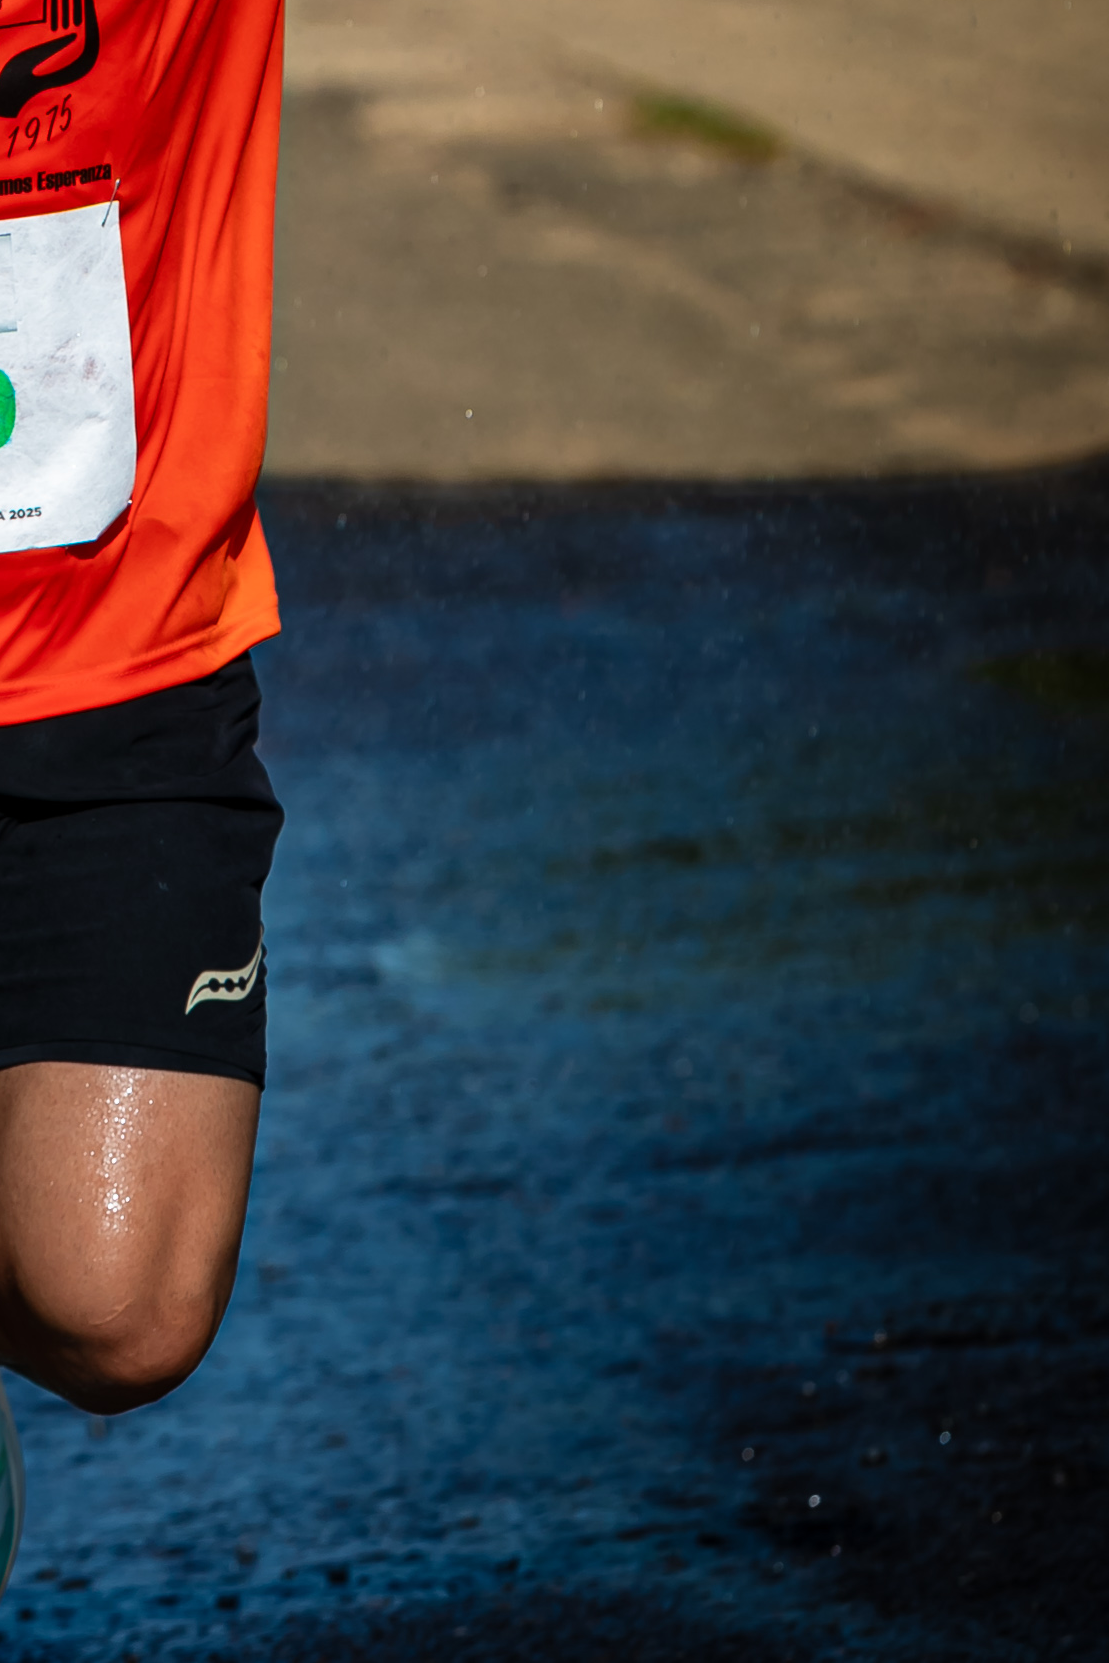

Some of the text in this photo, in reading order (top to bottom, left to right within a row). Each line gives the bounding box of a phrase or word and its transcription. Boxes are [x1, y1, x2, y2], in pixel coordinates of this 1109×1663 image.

[7, 94, 73, 159] 1975
[37, 163, 112, 191] Esperanza
[9, 507, 42, 520] 2025
